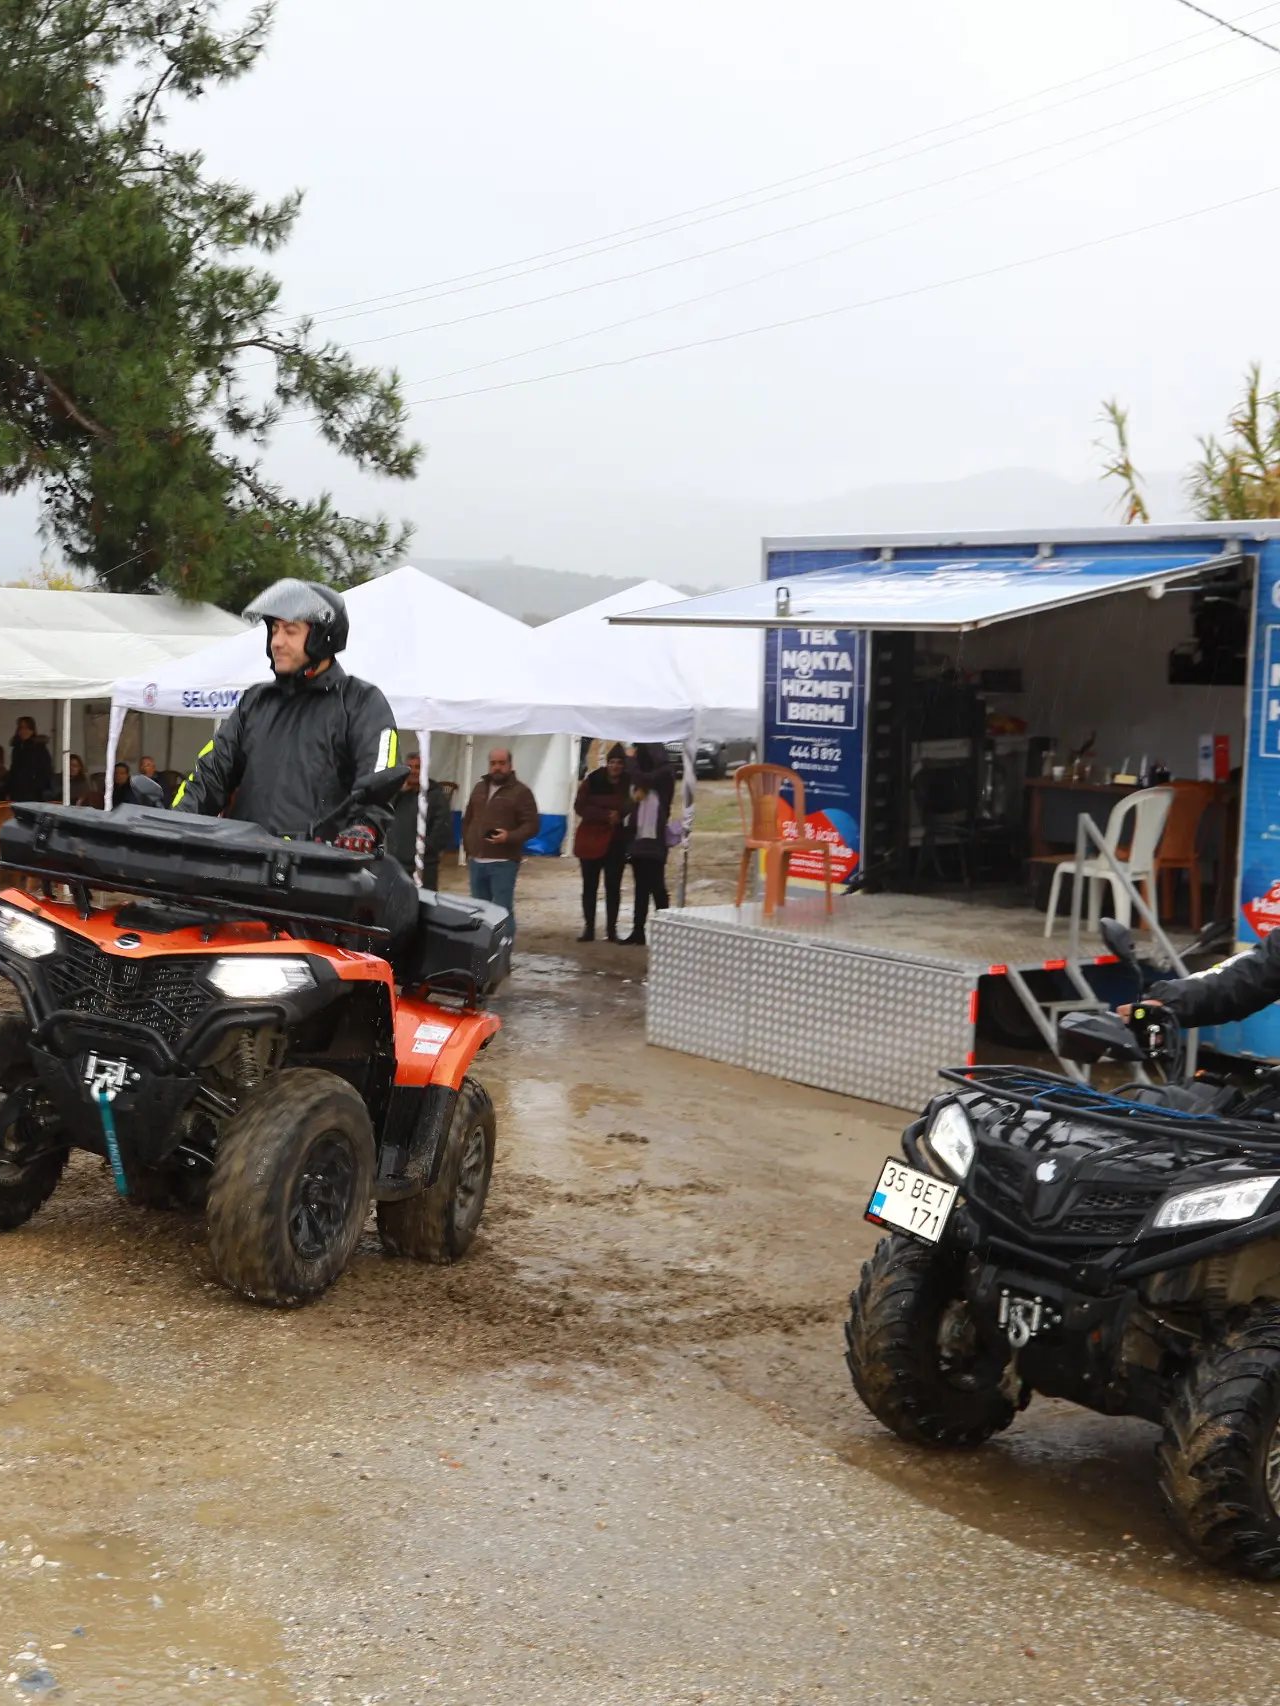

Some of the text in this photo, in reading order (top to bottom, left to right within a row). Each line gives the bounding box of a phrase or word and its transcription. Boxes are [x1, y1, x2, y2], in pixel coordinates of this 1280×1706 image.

[797, 629, 838, 645] TEK
[781, 650, 853, 671] NOKTA
[182, 690, 239, 711] SELÇUK
[789, 745, 842, 761] 444 8 892
[884, 1167, 950, 1208] 35 BET
[909, 1206, 940, 1235] 171
